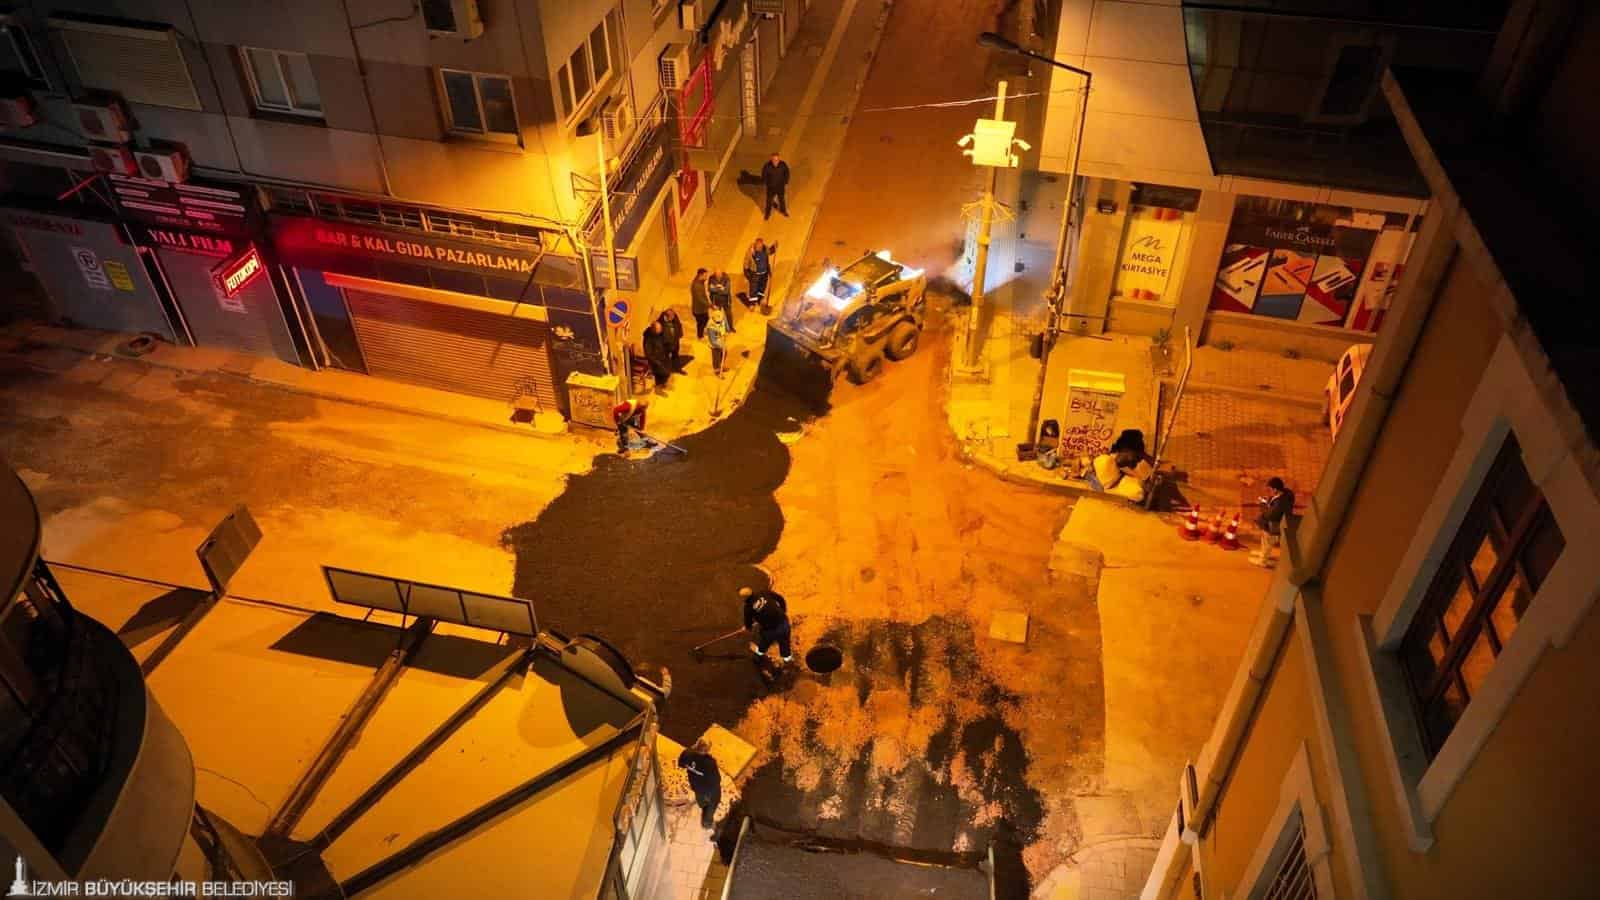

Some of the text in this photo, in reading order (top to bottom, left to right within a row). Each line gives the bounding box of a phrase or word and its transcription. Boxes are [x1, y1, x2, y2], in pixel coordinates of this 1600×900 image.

[351, 233, 362, 248] &
[363, 235, 396, 253] KAL
[396, 240, 433, 259] GIDA
[436, 247, 532, 272] PAZARLAMA
[1131, 252, 1161, 263] MEGA
